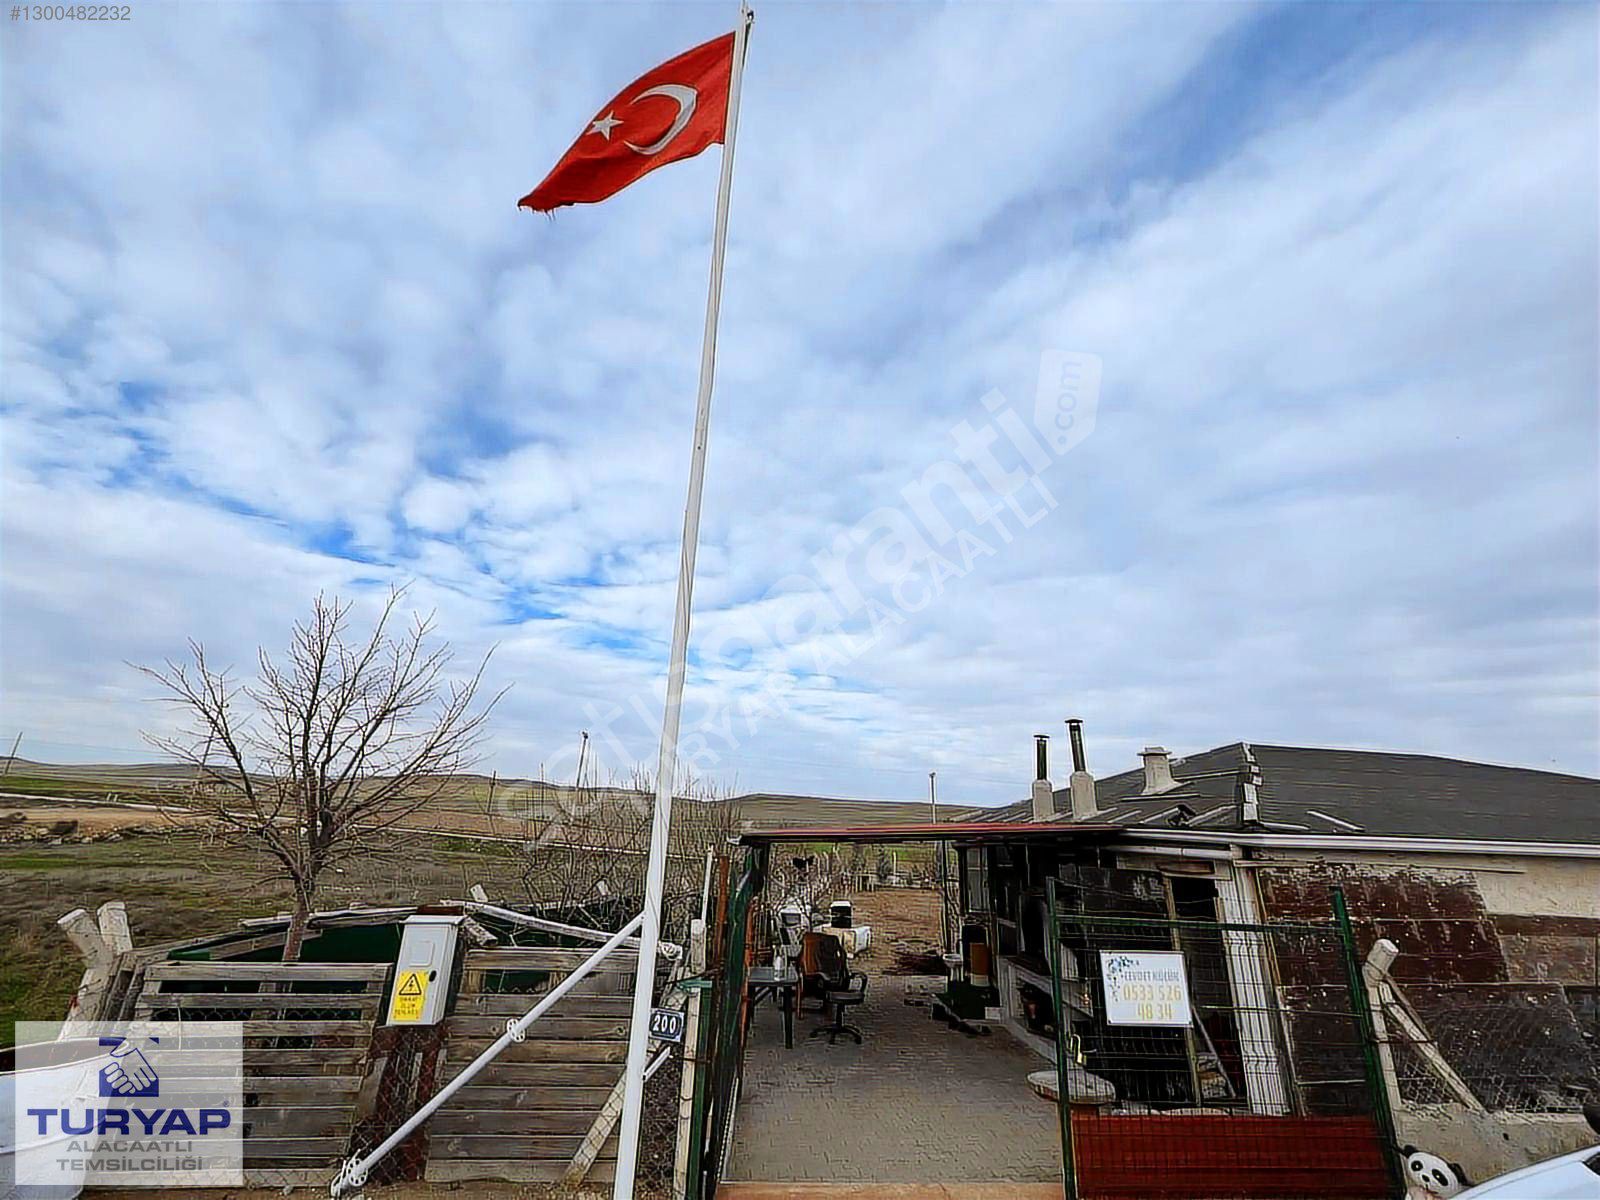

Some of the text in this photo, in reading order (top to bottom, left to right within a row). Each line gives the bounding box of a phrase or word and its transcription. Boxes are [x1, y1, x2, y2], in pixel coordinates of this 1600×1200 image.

[1123, 983, 1182, 1001] 0533 526
[1157, 1002, 1173, 1020] 34
[652, 1014, 677, 1034] 200
